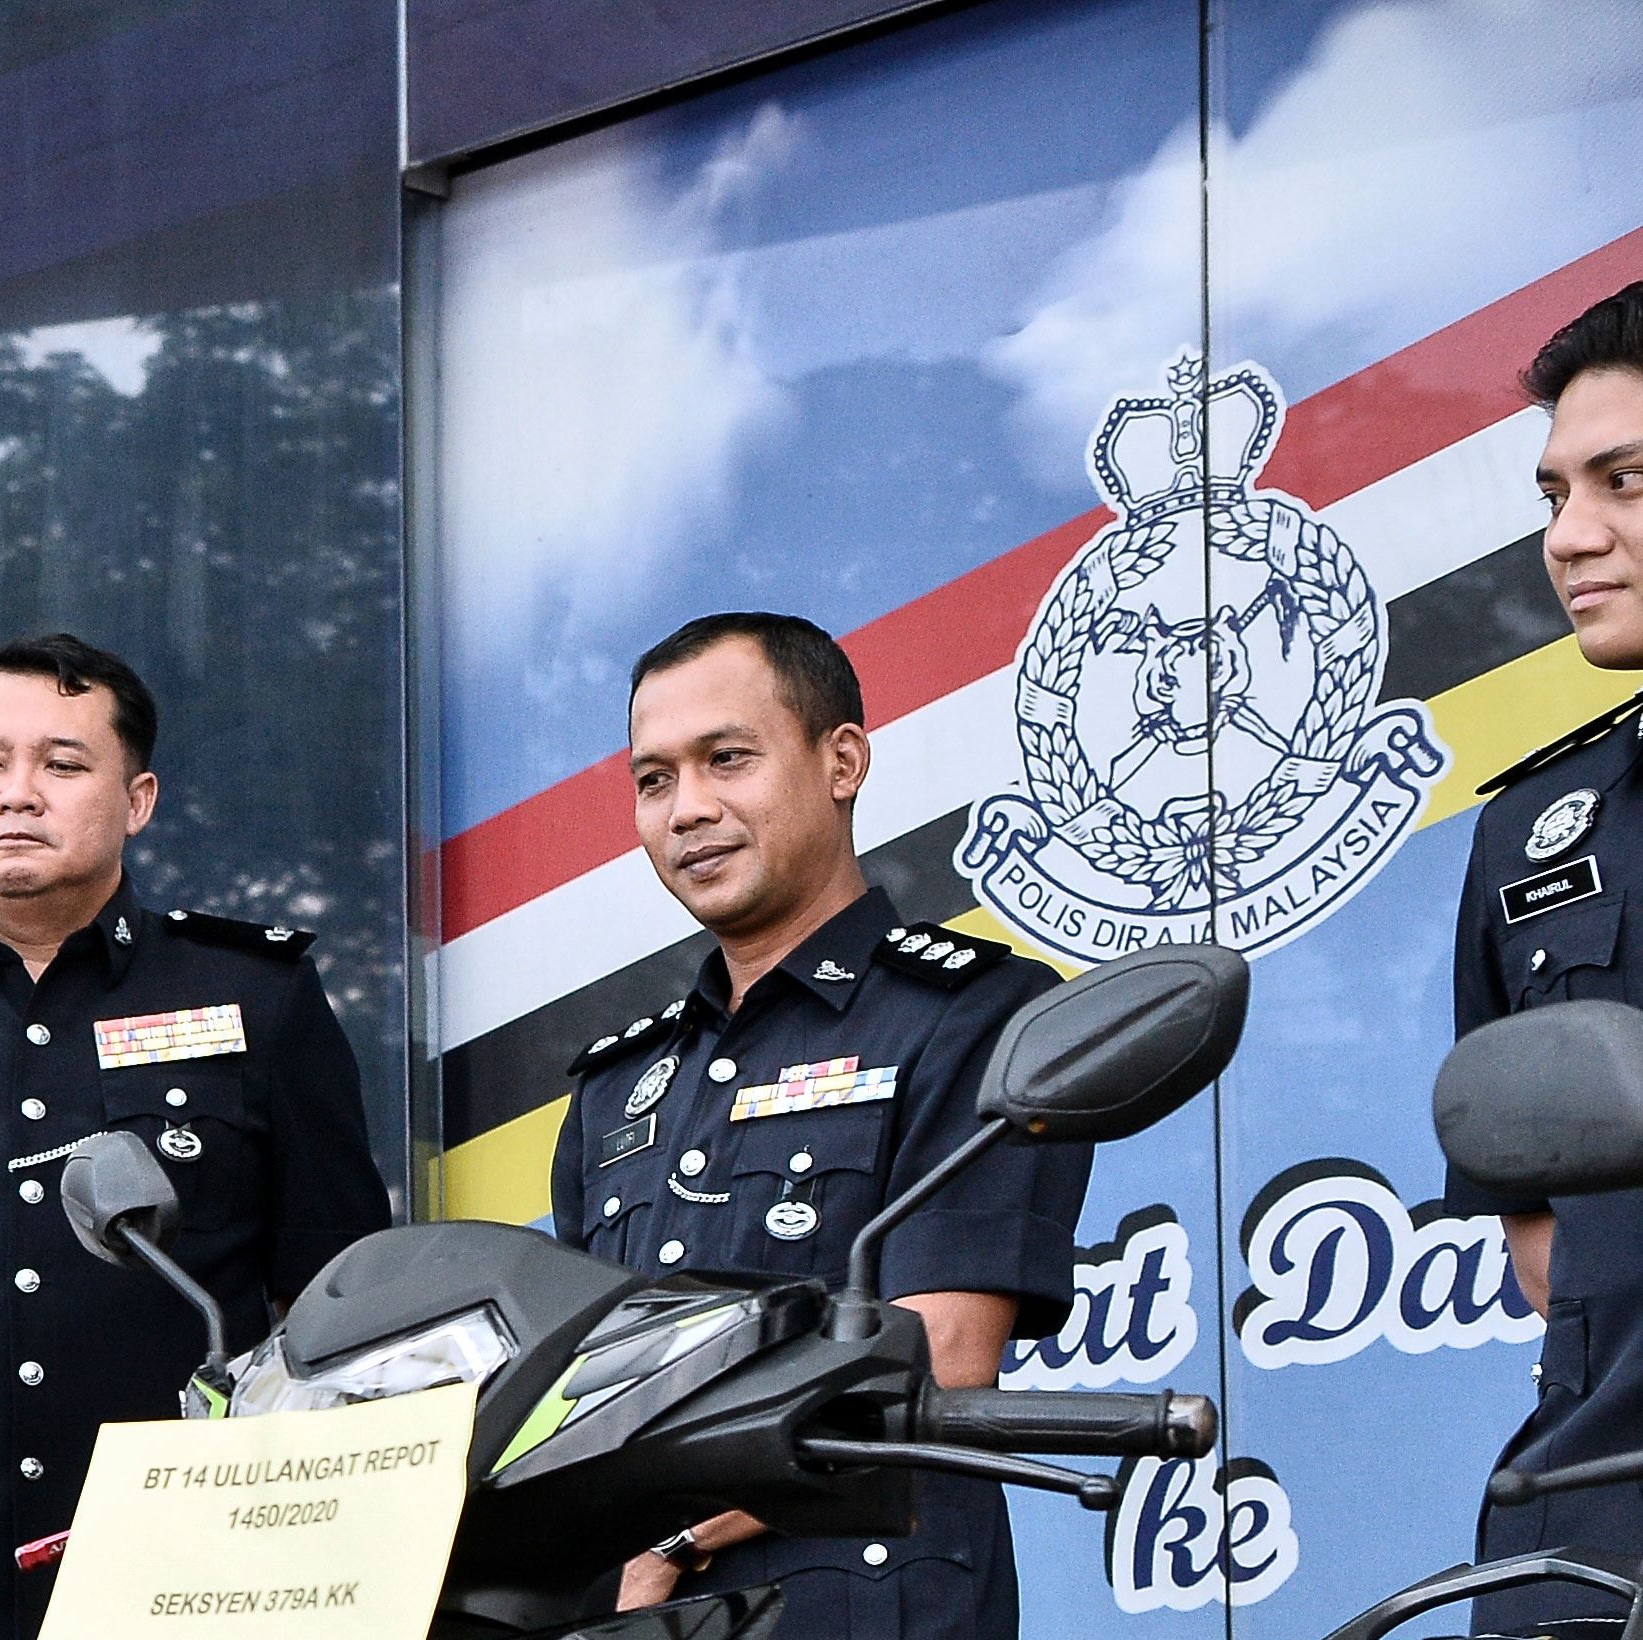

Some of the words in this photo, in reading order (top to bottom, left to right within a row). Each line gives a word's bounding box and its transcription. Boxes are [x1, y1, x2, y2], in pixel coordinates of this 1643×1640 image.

[999, 866, 1085, 937] POLIS
[1229, 797, 1401, 941] MALAYSIA
[1524, 878, 1574, 903] KHAIRUL
[143, 1466, 178, 1490] BT
[183, 1465, 208, 1489] 14
[214, 1463, 261, 1488] ULU
[264, 1452, 361, 1483] LANGAT
[364, 1440, 441, 1474] REPOT
[228, 1498, 339, 1530] 1450/2020
[1133, 1459, 1277, 1590] ke
[149, 1591, 260, 1616] SEKSYEN
[263, 1586, 319, 1613] 379A
[325, 1582, 360, 1607] KK
